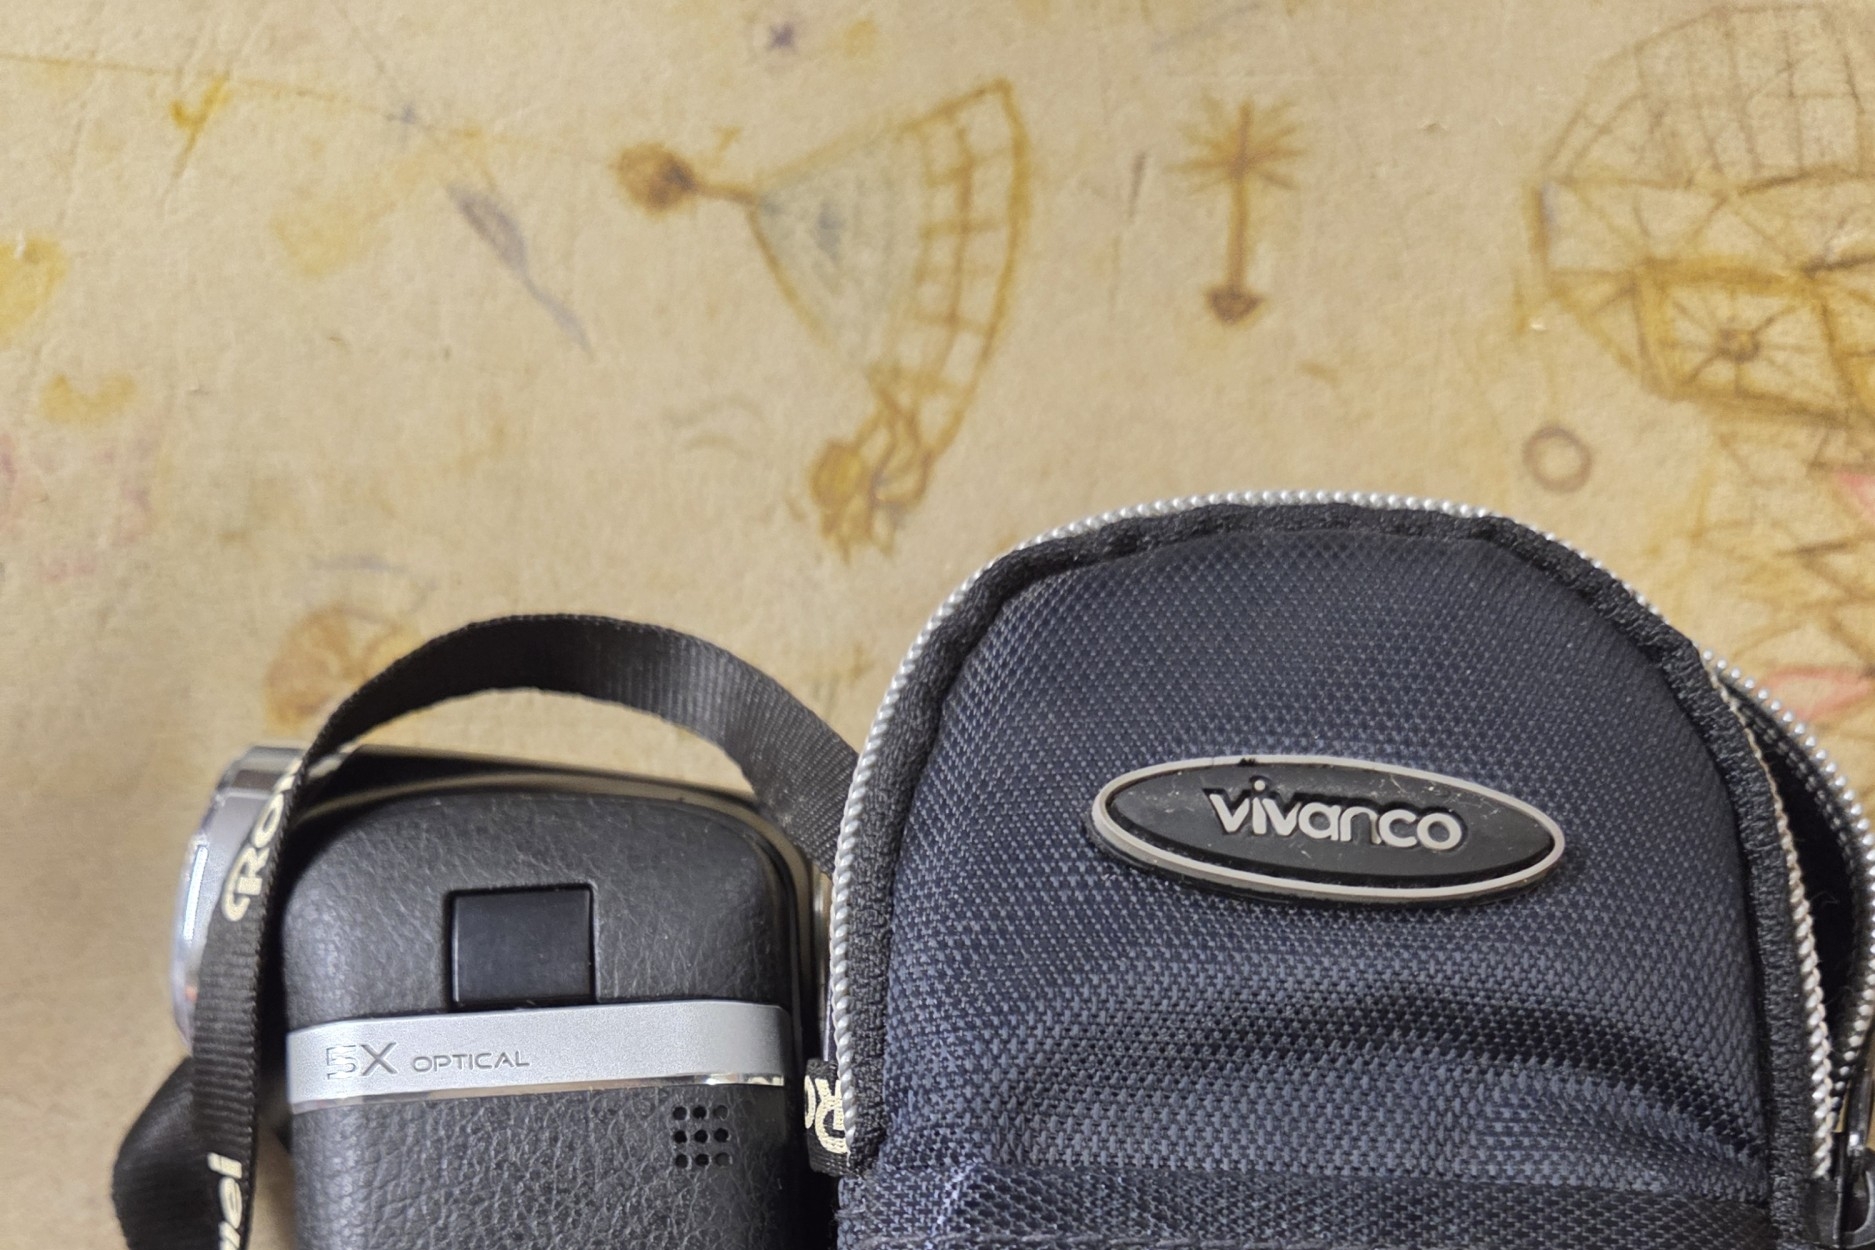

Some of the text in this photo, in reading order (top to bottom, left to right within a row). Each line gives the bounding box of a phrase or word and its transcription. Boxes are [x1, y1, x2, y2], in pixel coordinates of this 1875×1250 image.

[1208, 779, 1464, 852] vivanco
[325, 1041, 531, 1081] 5X OPTICAL
